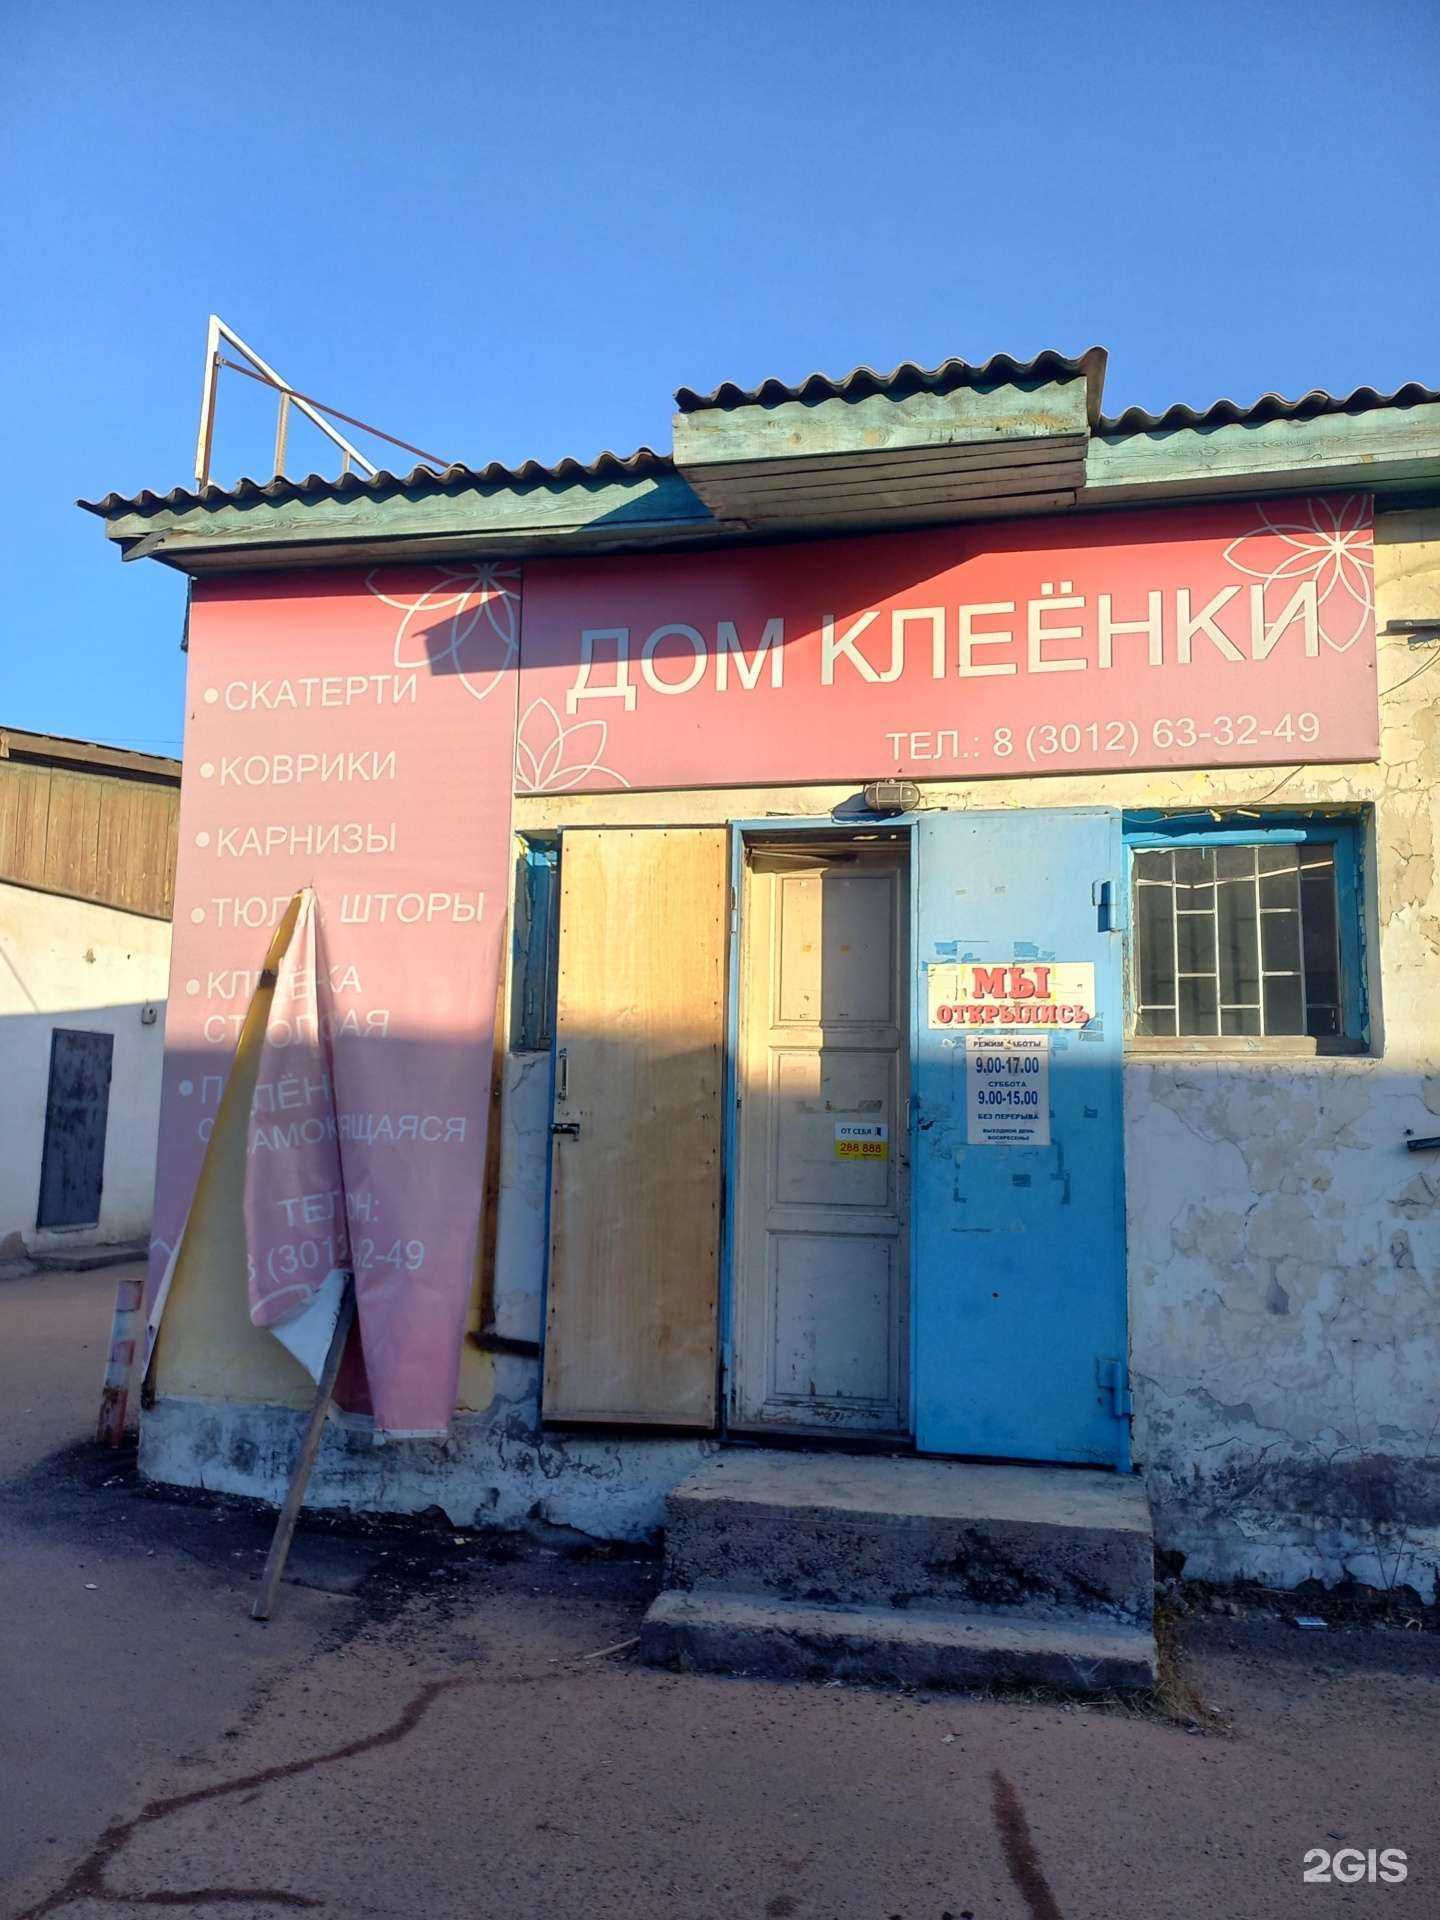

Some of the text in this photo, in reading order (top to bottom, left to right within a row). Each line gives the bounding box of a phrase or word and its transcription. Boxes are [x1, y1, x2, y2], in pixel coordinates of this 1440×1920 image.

[565, 580, 1321, 714] ДОМ КЛЕЁНКИ
[224, 673, 418, 712] СКАТЕРТИ
[885, 711, 1321, 762] ТЕЛ.: 8 (3012) 63-32-49
[219, 750, 397, 786] КОВРИКИ
[216, 821, 397, 858] КАРНИЗЫ
[339, 891, 485, 925] ШТОРЫ
[972, 967, 1052, 999] МЫ
[936, 1004, 1091, 1026] ОТКРЫЛИСЬ
[974, 1040, 1004, 1048] РЕЖИМ
[976, 1056, 1039, 1073] 9.00-17.00
[978, 1090, 1038, 1105] 9.00-15.00
